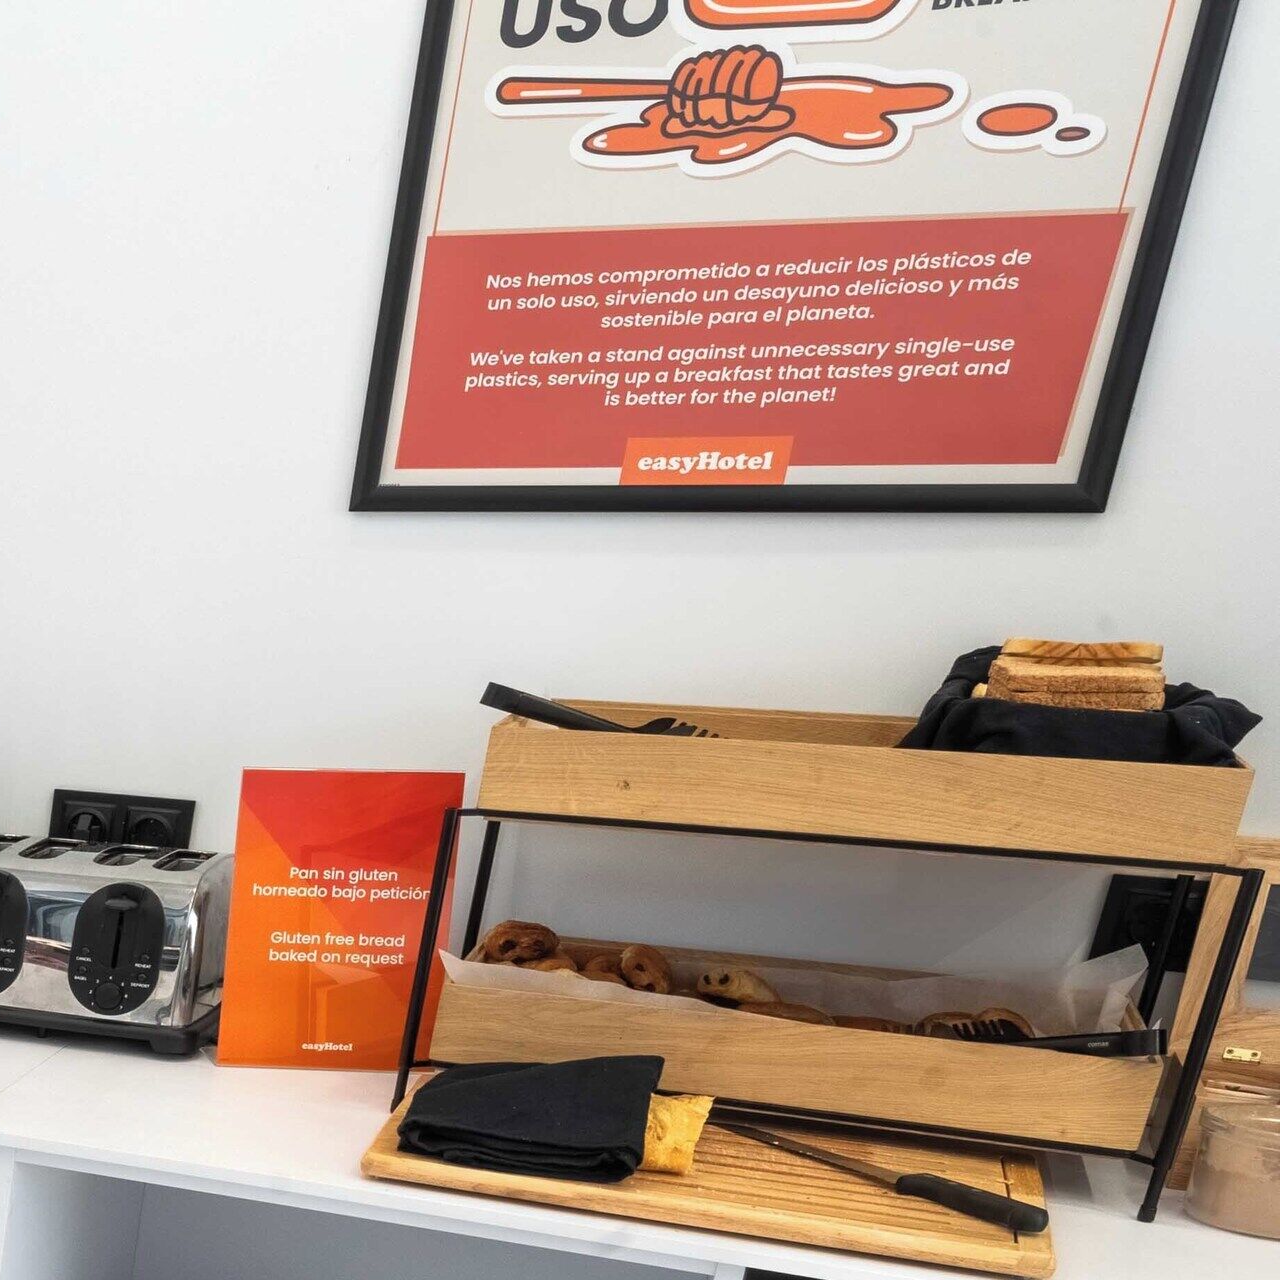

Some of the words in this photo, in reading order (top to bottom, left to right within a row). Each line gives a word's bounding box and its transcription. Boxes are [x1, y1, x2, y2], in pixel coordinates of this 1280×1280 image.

[486, 274, 522, 289] Nos
[526, 272, 594, 288] hemos
[597, 262, 751, 287] comprometido
[755, 264, 771, 277] a
[774, 256, 853, 276] reducir
[856, 256, 889, 273] los
[892, 250, 997, 276] plásticos
[1001, 248, 1032, 266] de
[487, 297, 512, 311] un
[516, 293, 557, 310] solo
[560, 294, 600, 309] uso,
[604, 287, 698, 307] sirviendo
[702, 289, 729, 302] un
[733, 284, 840, 304] desayuno
[844, 277, 944, 297] delicioso
[948, 279, 964, 298] y
[967, 272, 1020, 292] más
[600, 309, 704, 329] sostenible
[706, 310, 758, 330] para
[762, 306, 783, 323] el
[785, 304, 875, 327] planeta.
[470, 349, 525, 367] We've
[529, 348, 583, 365] taken
[587, 350, 602, 363] a
[605, 345, 664, 363] stand
[667, 343, 747, 366] against
[750, 342, 891, 360] unnecessary
[894, 336, 1016, 359] single-use
[464, 370, 542, 393] plastics,
[547, 369, 620, 390] serving
[624, 371, 651, 389] up
[654, 370, 669, 384] a
[673, 365, 774, 383] breakfast
[777, 364, 823, 381] that
[827, 363, 894, 379] tastes
[897, 361, 960, 383] great
[964, 358, 1011, 376] and
[604, 390, 621, 407] is
[624, 390, 687, 406] better
[689, 388, 719, 405] for
[722, 388, 757, 404] the
[759, 386, 837, 409] planet!
[637, 451, 774, 475] easyHotel
[290, 866, 319, 880] Pan
[323, 867, 345, 880] sin
[348, 868, 398, 885] gluten
[253, 884, 328, 898] horneado
[331, 885, 367, 902] bajo
[271, 931, 321, 945] Gluten
[324, 932, 355, 946] free
[358, 933, 405, 947] bread
[269, 949, 317, 962] baked
[321, 952, 341, 963] on
[345, 953, 404, 967] request
